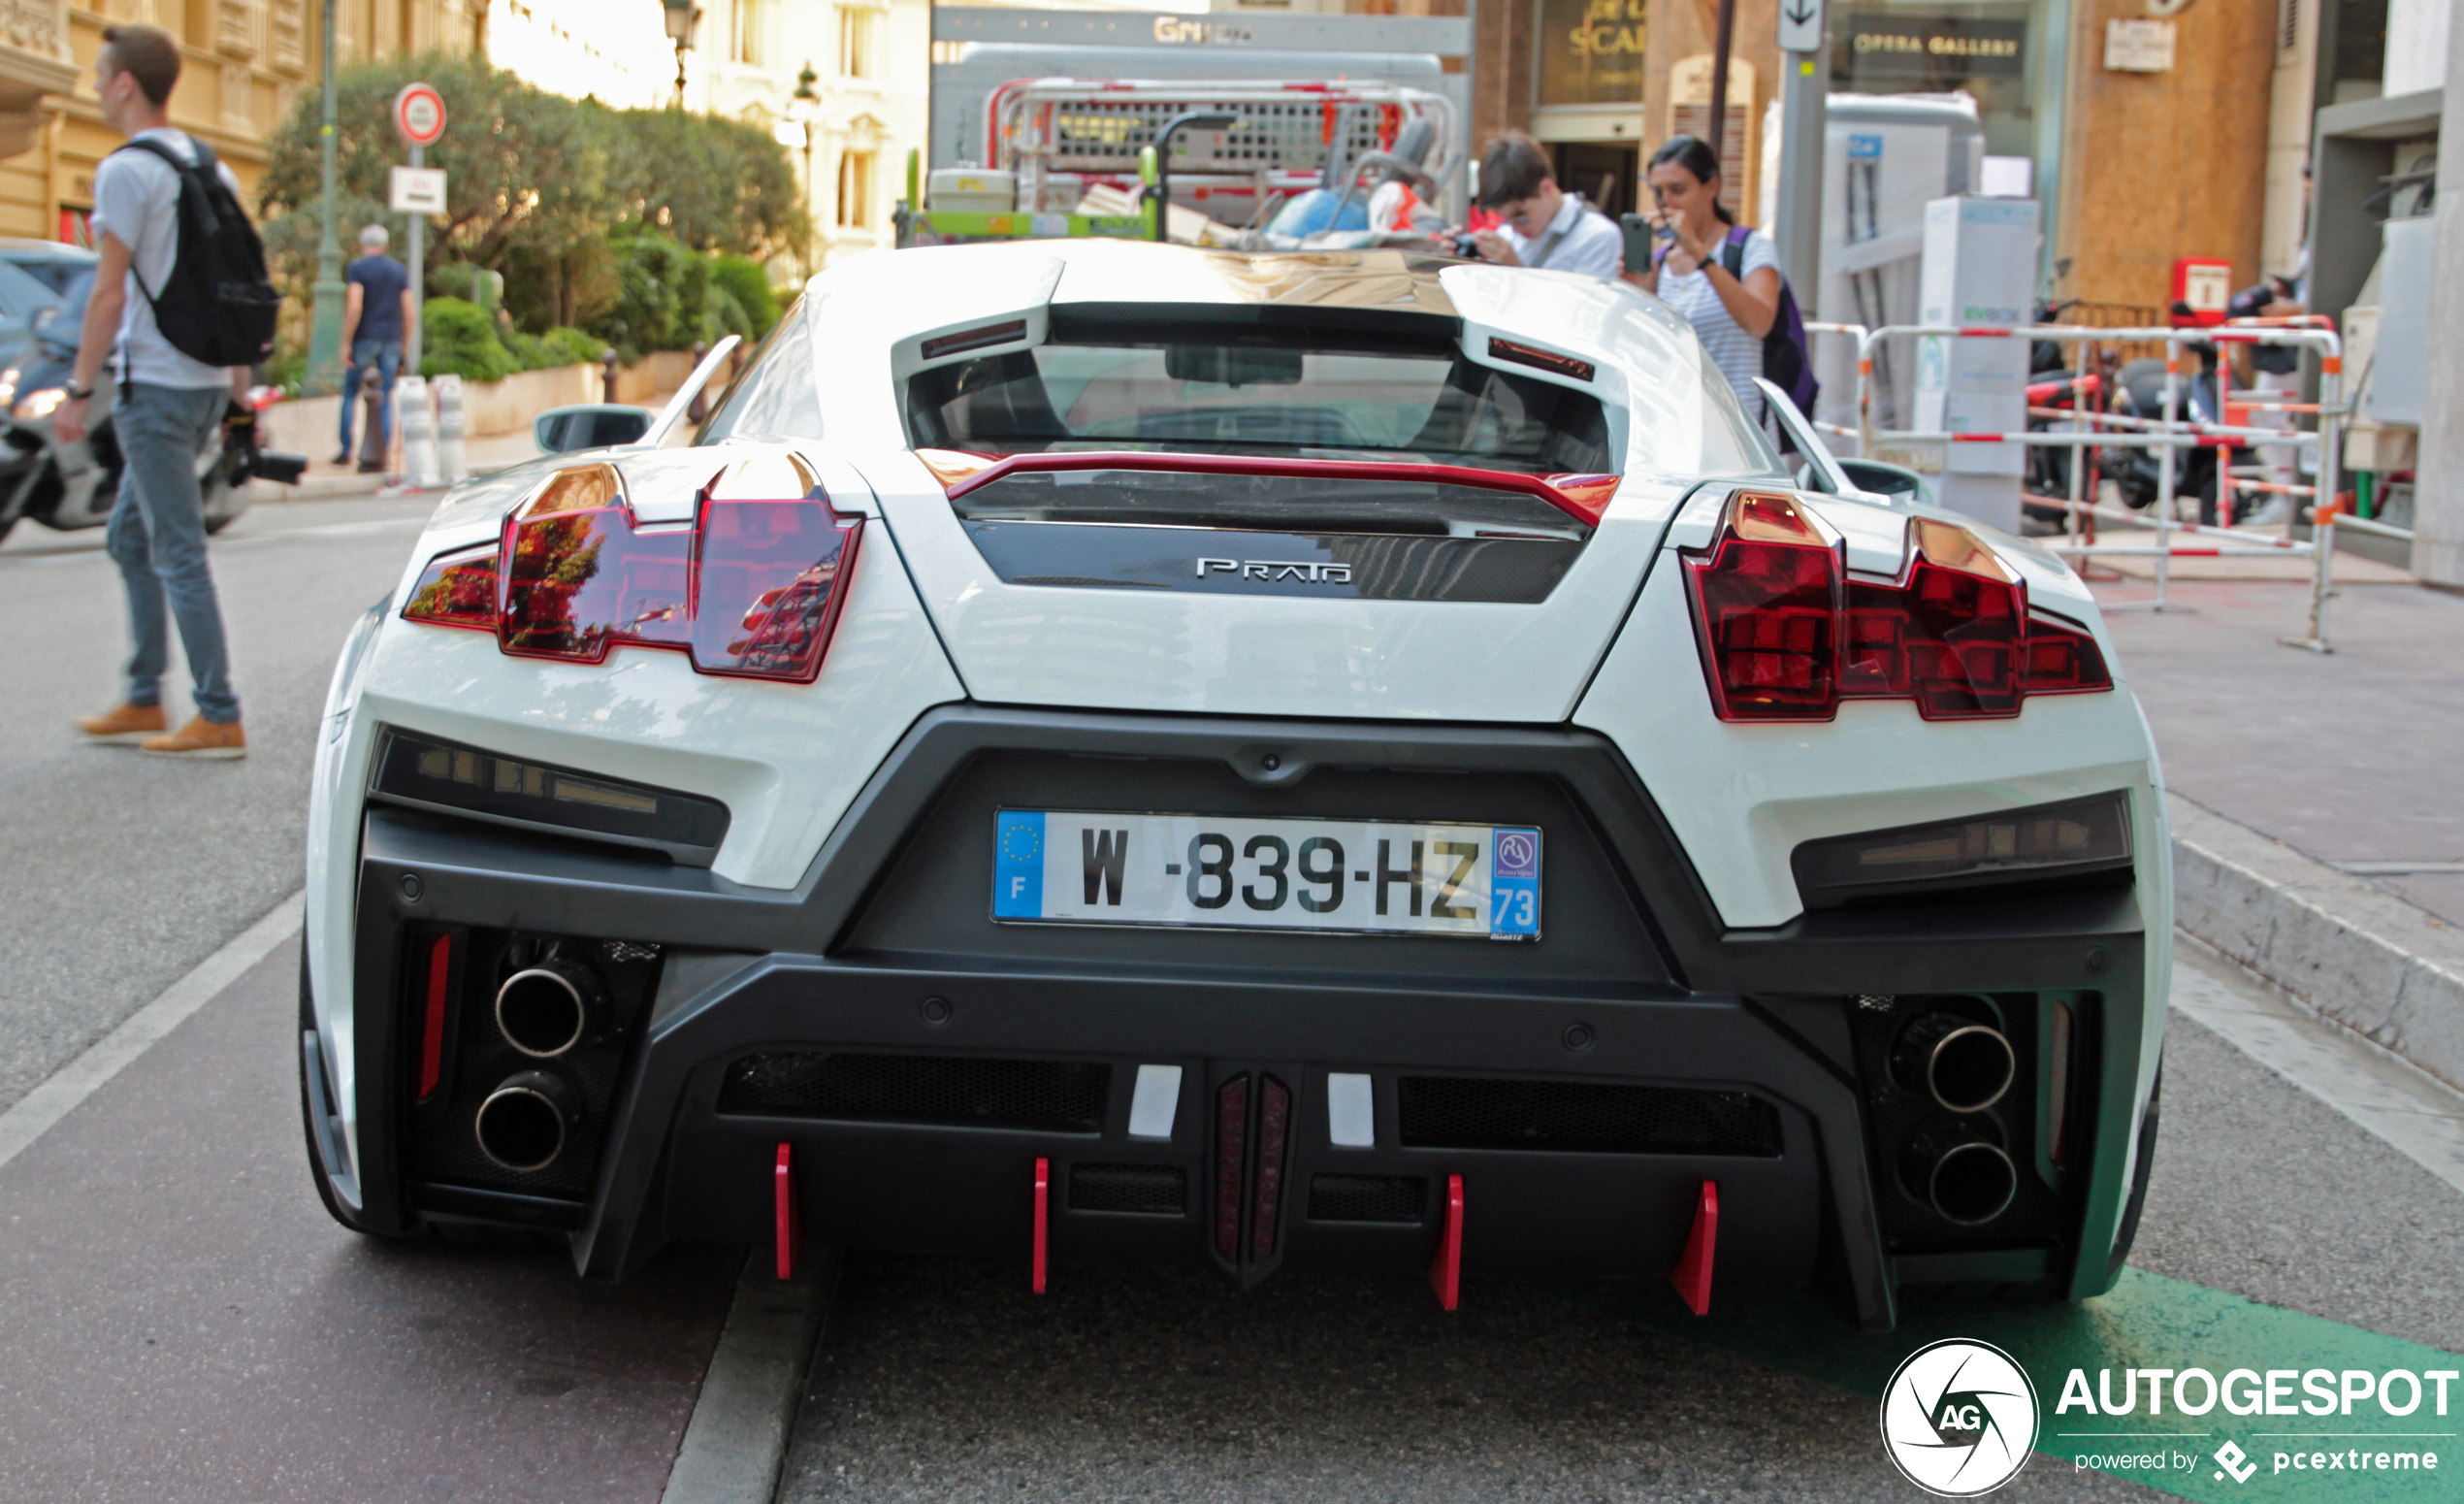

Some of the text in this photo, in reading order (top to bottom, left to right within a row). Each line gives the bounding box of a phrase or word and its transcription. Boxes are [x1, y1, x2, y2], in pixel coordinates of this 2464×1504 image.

[1854, 33, 2019, 57] OPERA GALLERY
[1011, 876, 1026, 899] F
[1494, 888, 1535, 926] 73
